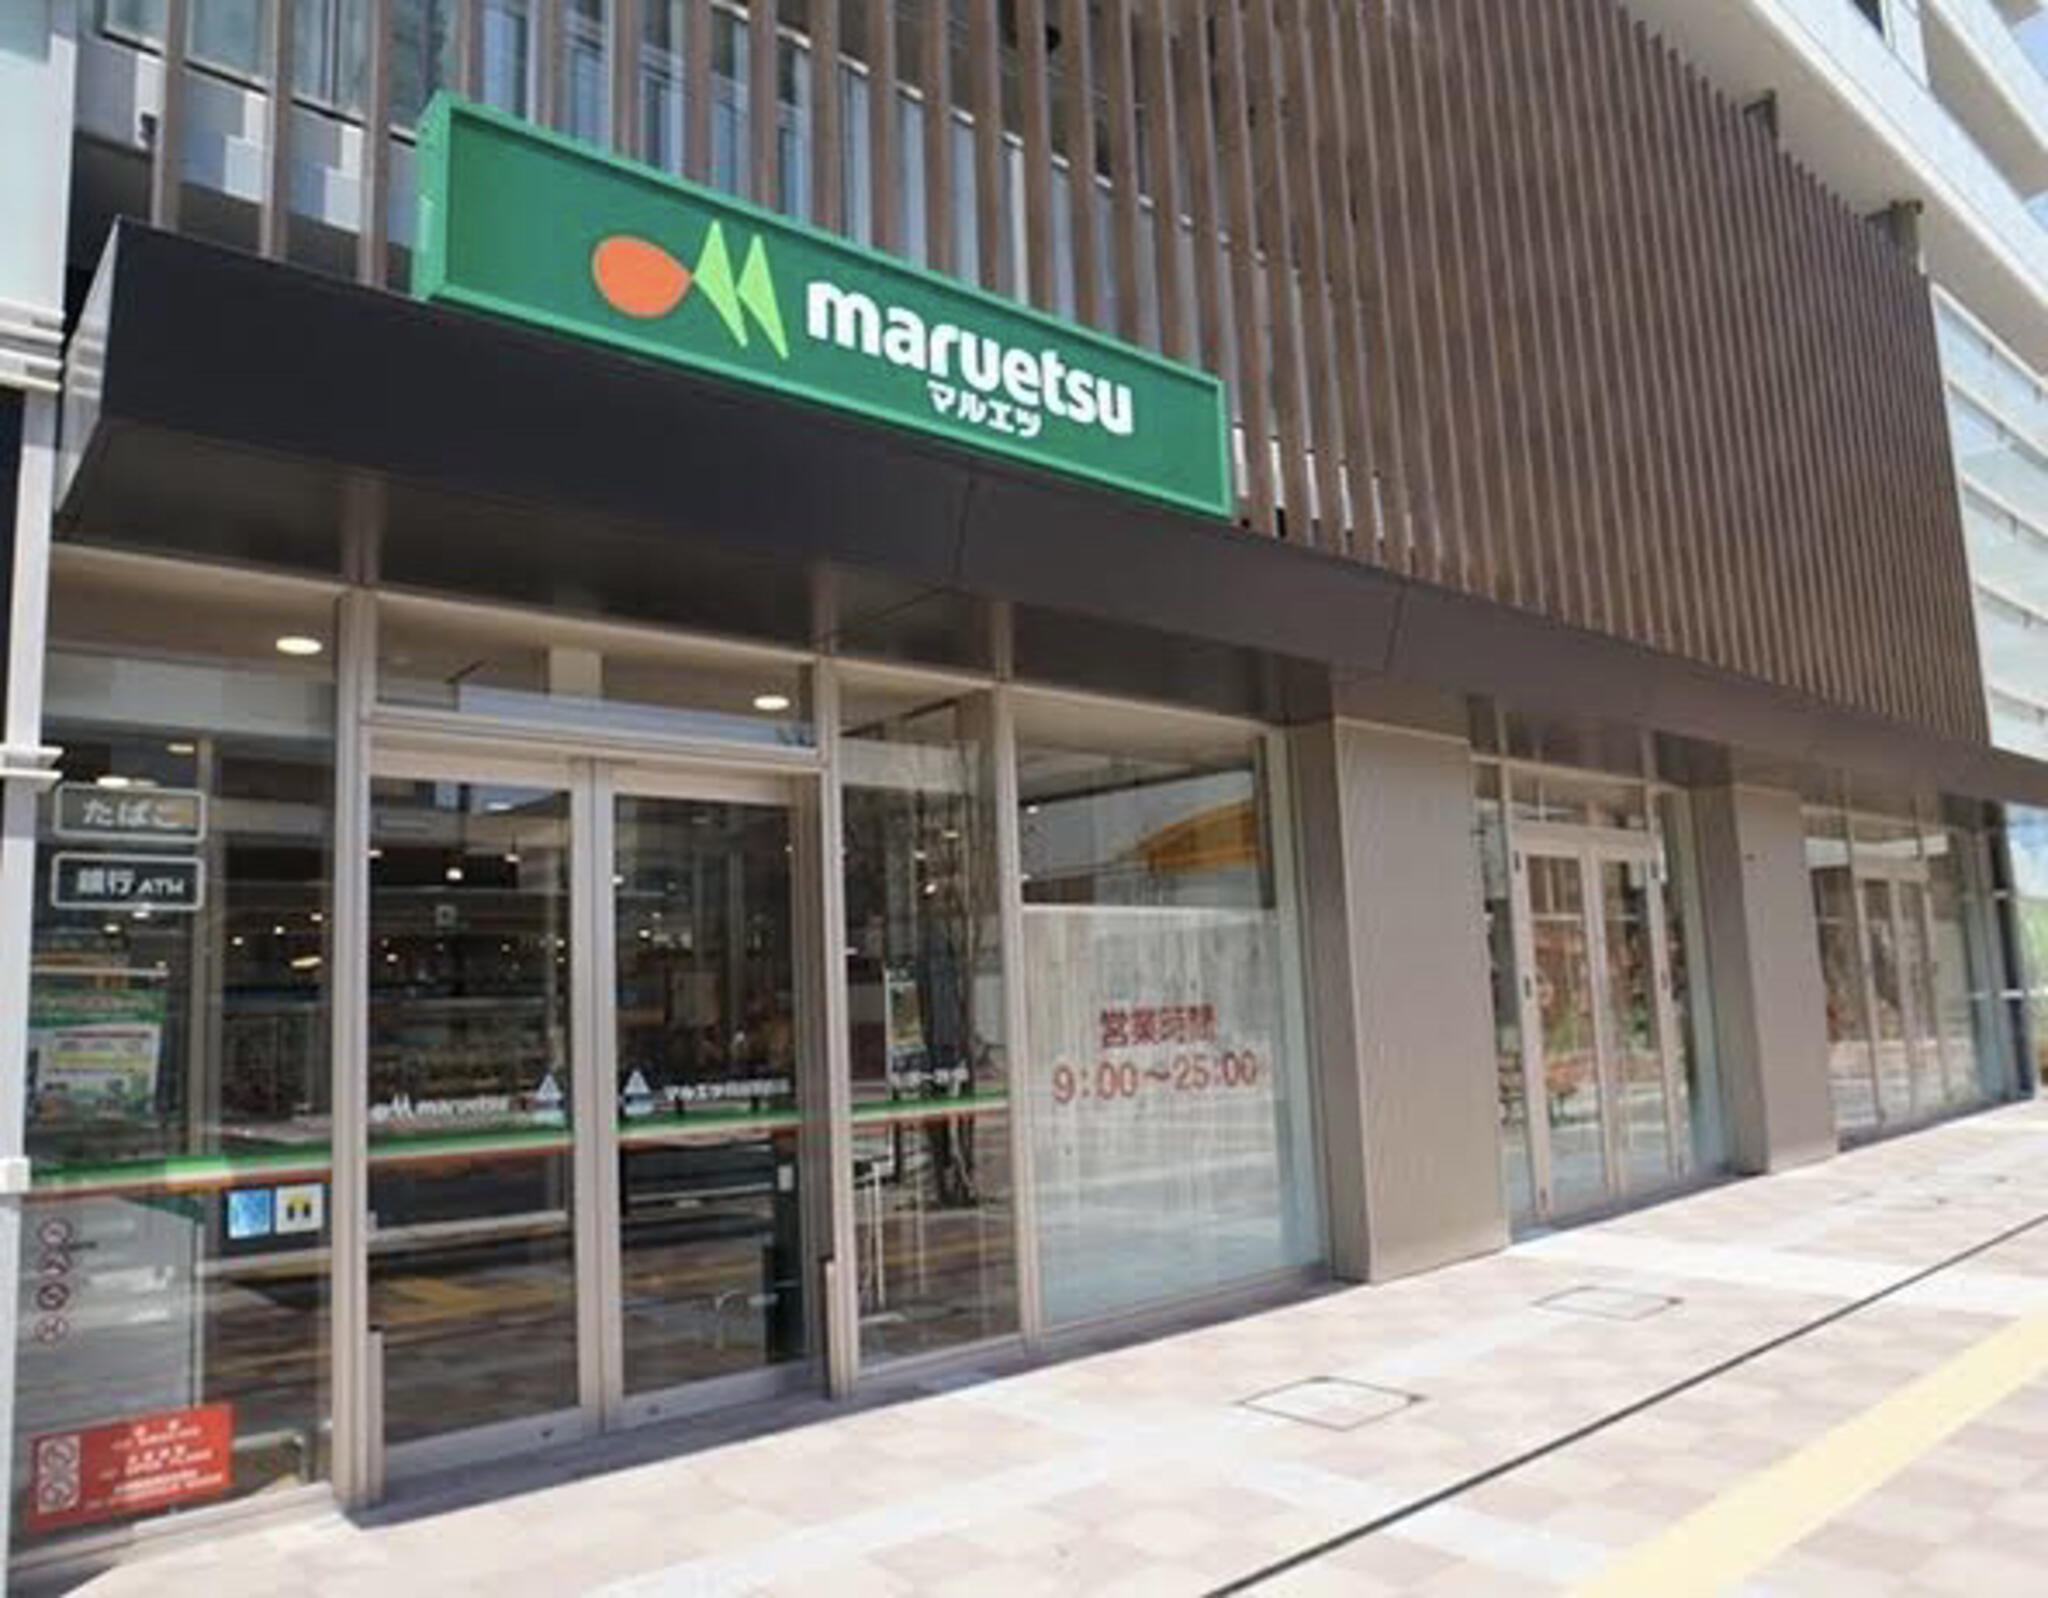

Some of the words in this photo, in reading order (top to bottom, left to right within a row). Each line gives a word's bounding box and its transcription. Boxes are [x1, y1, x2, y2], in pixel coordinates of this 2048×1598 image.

[806, 280, 1134, 436] maruetsu
[926, 379, 1041, 437] マルエツ
[82, 799, 184, 830] たばこ
